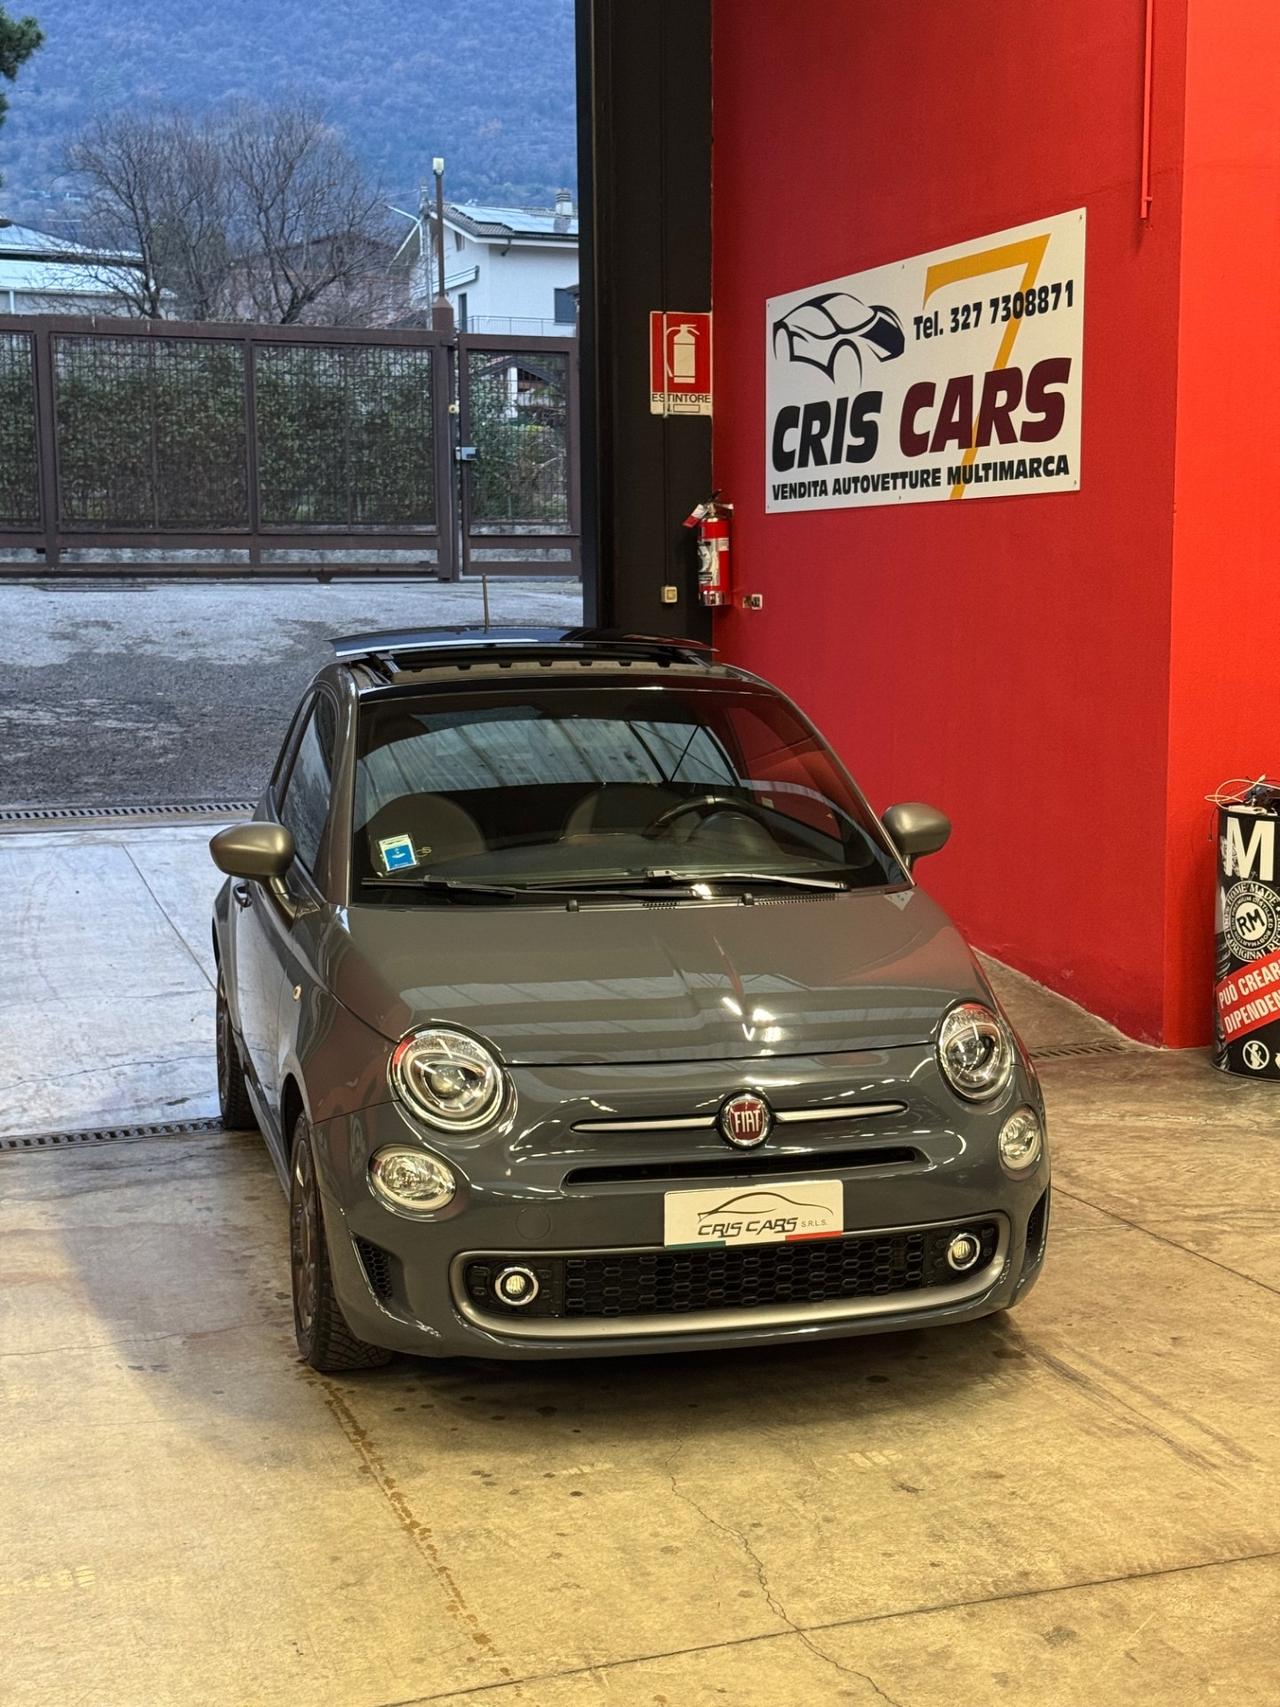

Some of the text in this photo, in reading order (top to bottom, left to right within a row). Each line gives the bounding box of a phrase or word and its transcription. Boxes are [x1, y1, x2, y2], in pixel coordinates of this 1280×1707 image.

[914, 279, 1074, 340] Tel. 327 7308871
[652, 393, 711, 403] ESTINTORE
[772, 357, 1072, 472] CRIS CARS
[772, 454, 1070, 500] VENDITA AUTOVETTURE MULTIMARCA
[1227, 883, 1277, 907] HOME MADE
[1236, 908, 1265, 936] RM
[1228, 939, 1266, 960] ORIGINAL
[1219, 959, 1280, 1009] PUÒ CREAR
[734, 1110, 760, 1133] FIAT
[698, 1222, 742, 1239] CRIS
[745, 1217, 799, 1235] CARS
